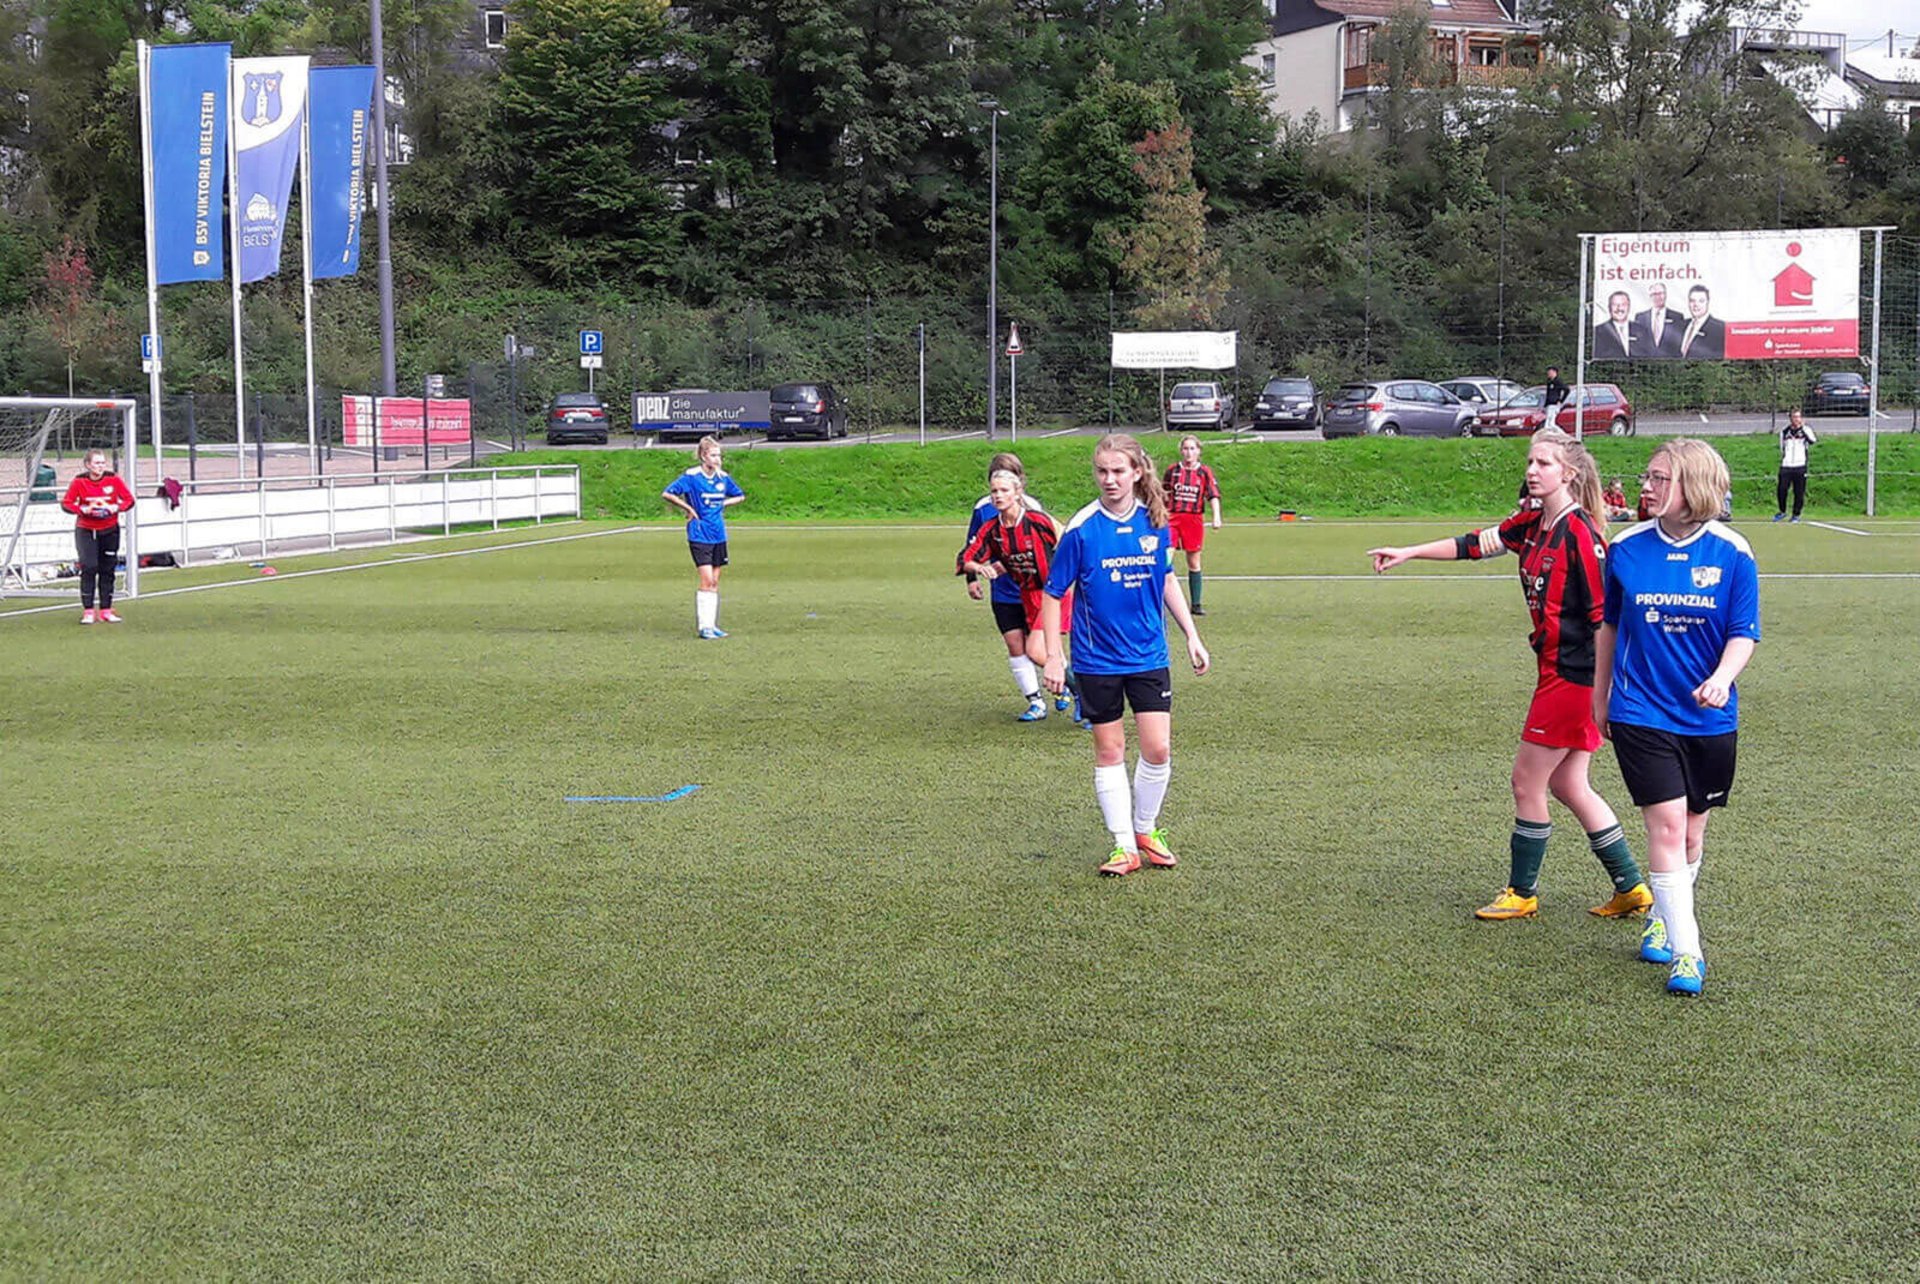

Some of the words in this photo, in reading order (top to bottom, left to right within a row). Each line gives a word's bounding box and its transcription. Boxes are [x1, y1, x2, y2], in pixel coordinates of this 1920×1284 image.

[200, 92, 215, 155] BIELSTEIN
[352, 109, 364, 167] BIELSTEIN
[197, 158, 211, 218] VIKTORIA
[349, 169, 360, 222] VIKTORIA
[196, 220, 208, 245] BSV
[1602, 238, 1690, 257] Eigentum
[1601, 264, 1624, 280] ist
[1629, 263, 1702, 280] einfach.
[585, 334, 597, 350] P
[637, 396, 670, 424] penz
[672, 398, 691, 409] die
[1102, 555, 1157, 569] PROVINZIAL
[1635, 593, 1718, 609] PROVINZIAL
